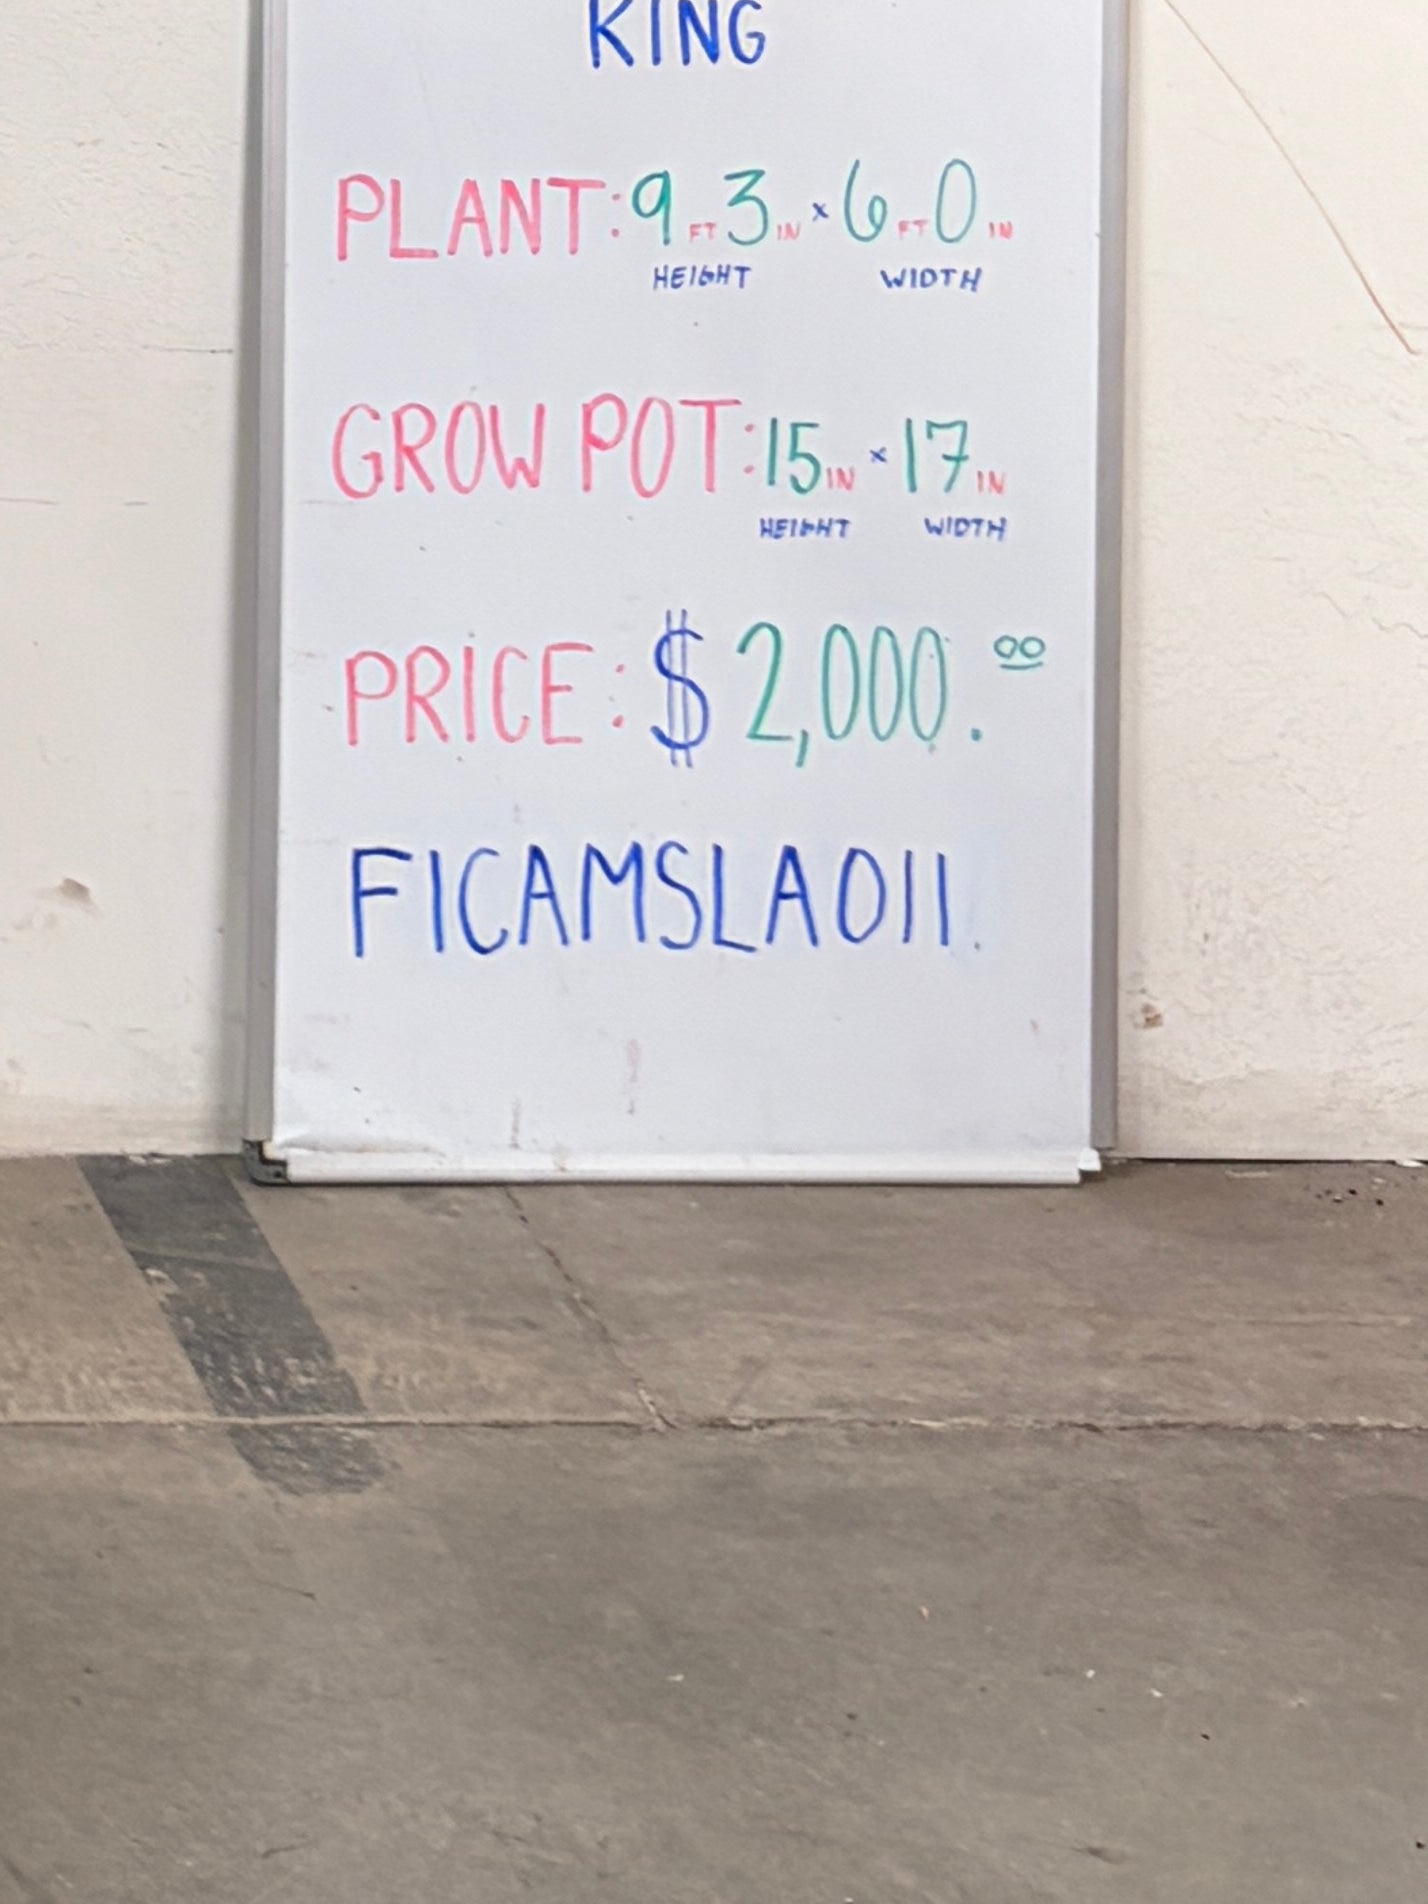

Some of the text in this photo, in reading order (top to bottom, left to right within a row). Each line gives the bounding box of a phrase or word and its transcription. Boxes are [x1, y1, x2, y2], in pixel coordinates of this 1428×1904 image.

[336, 173, 625, 262] PLANT:
[653, 265, 981, 292] HEIGHT WIDTH
[332, 403, 546, 500] GROW
[580, 392, 756, 499] POT:
[759, 517, 1006, 540] HEIGHT WIDTH
[343, 642, 625, 748] PRICE:
